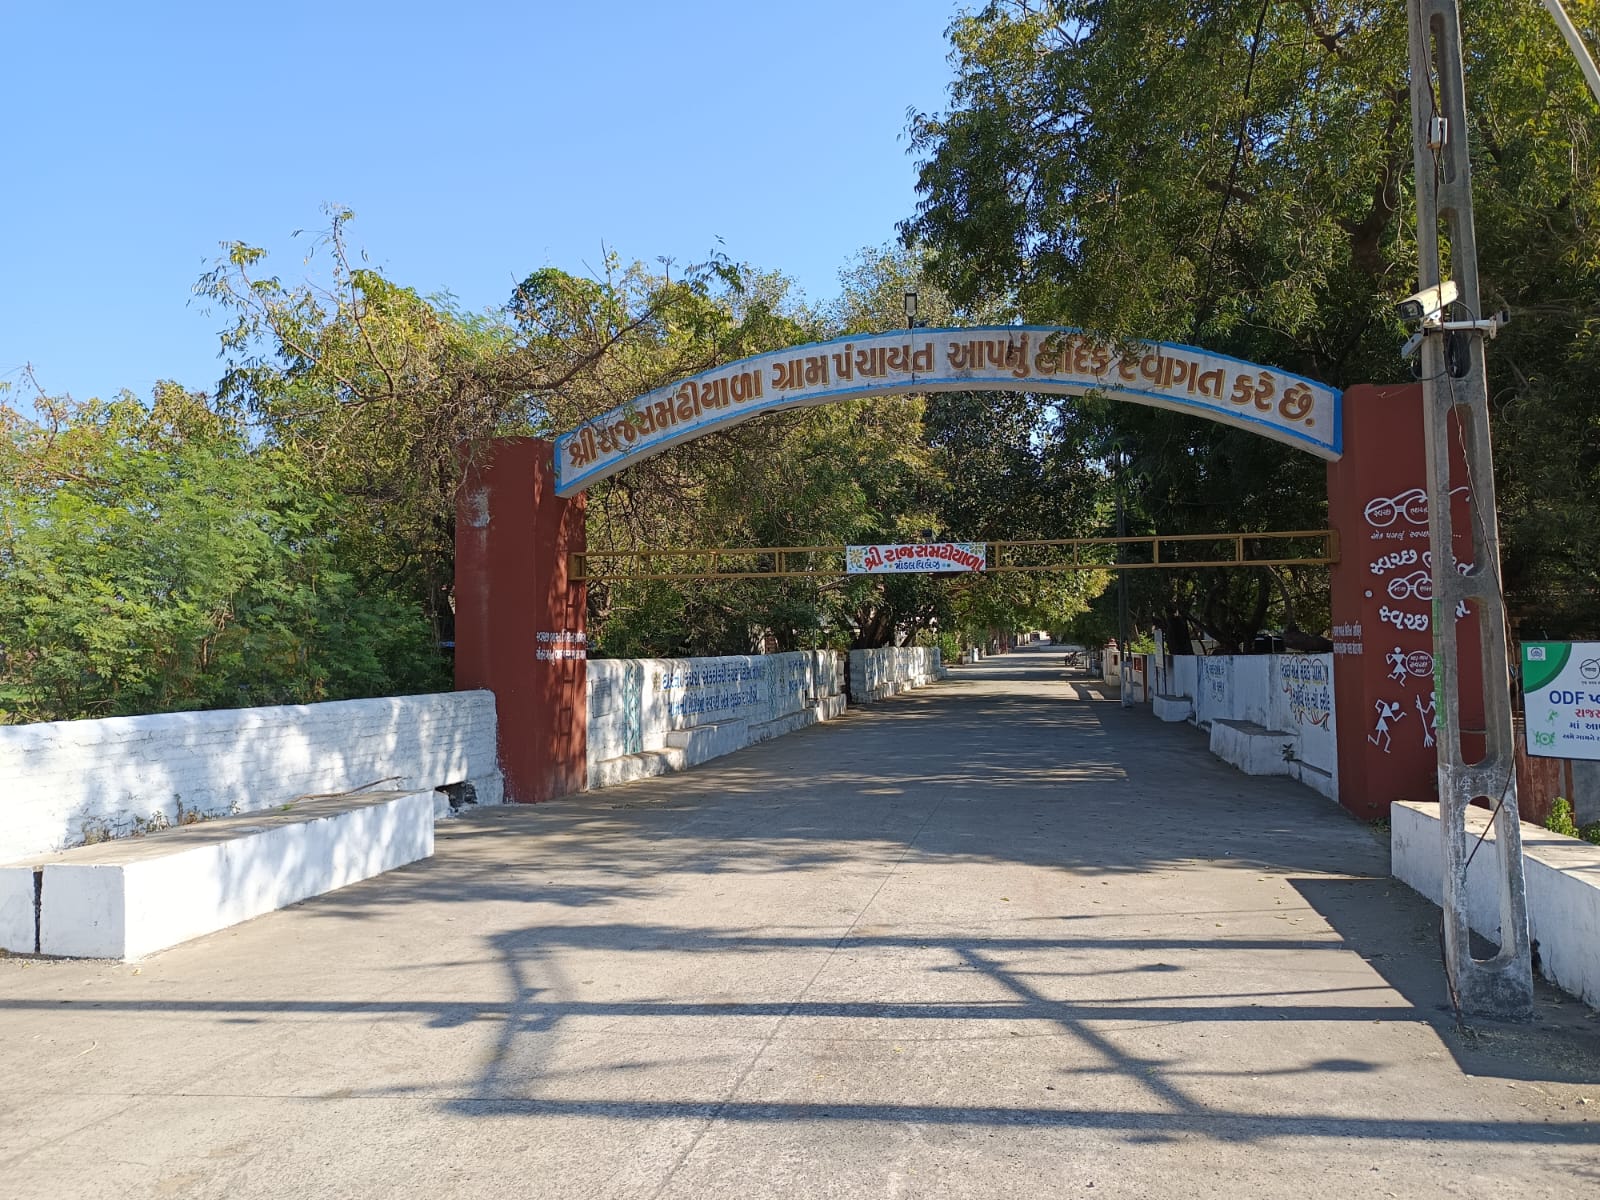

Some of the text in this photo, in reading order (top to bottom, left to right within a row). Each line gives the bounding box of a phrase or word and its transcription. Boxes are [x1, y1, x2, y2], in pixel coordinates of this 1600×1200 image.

[772, 353, 829, 391] ગ્રામ
[832, 342, 934, 382] પંચાયત
[947, 332, 1031, 378] આપનું
[1231, 371, 1276, 413] કરે
[864, 543, 985, 572] શ્રી રાજસમઢીયાળા
[1549, 690, 1584, 705] ODF
